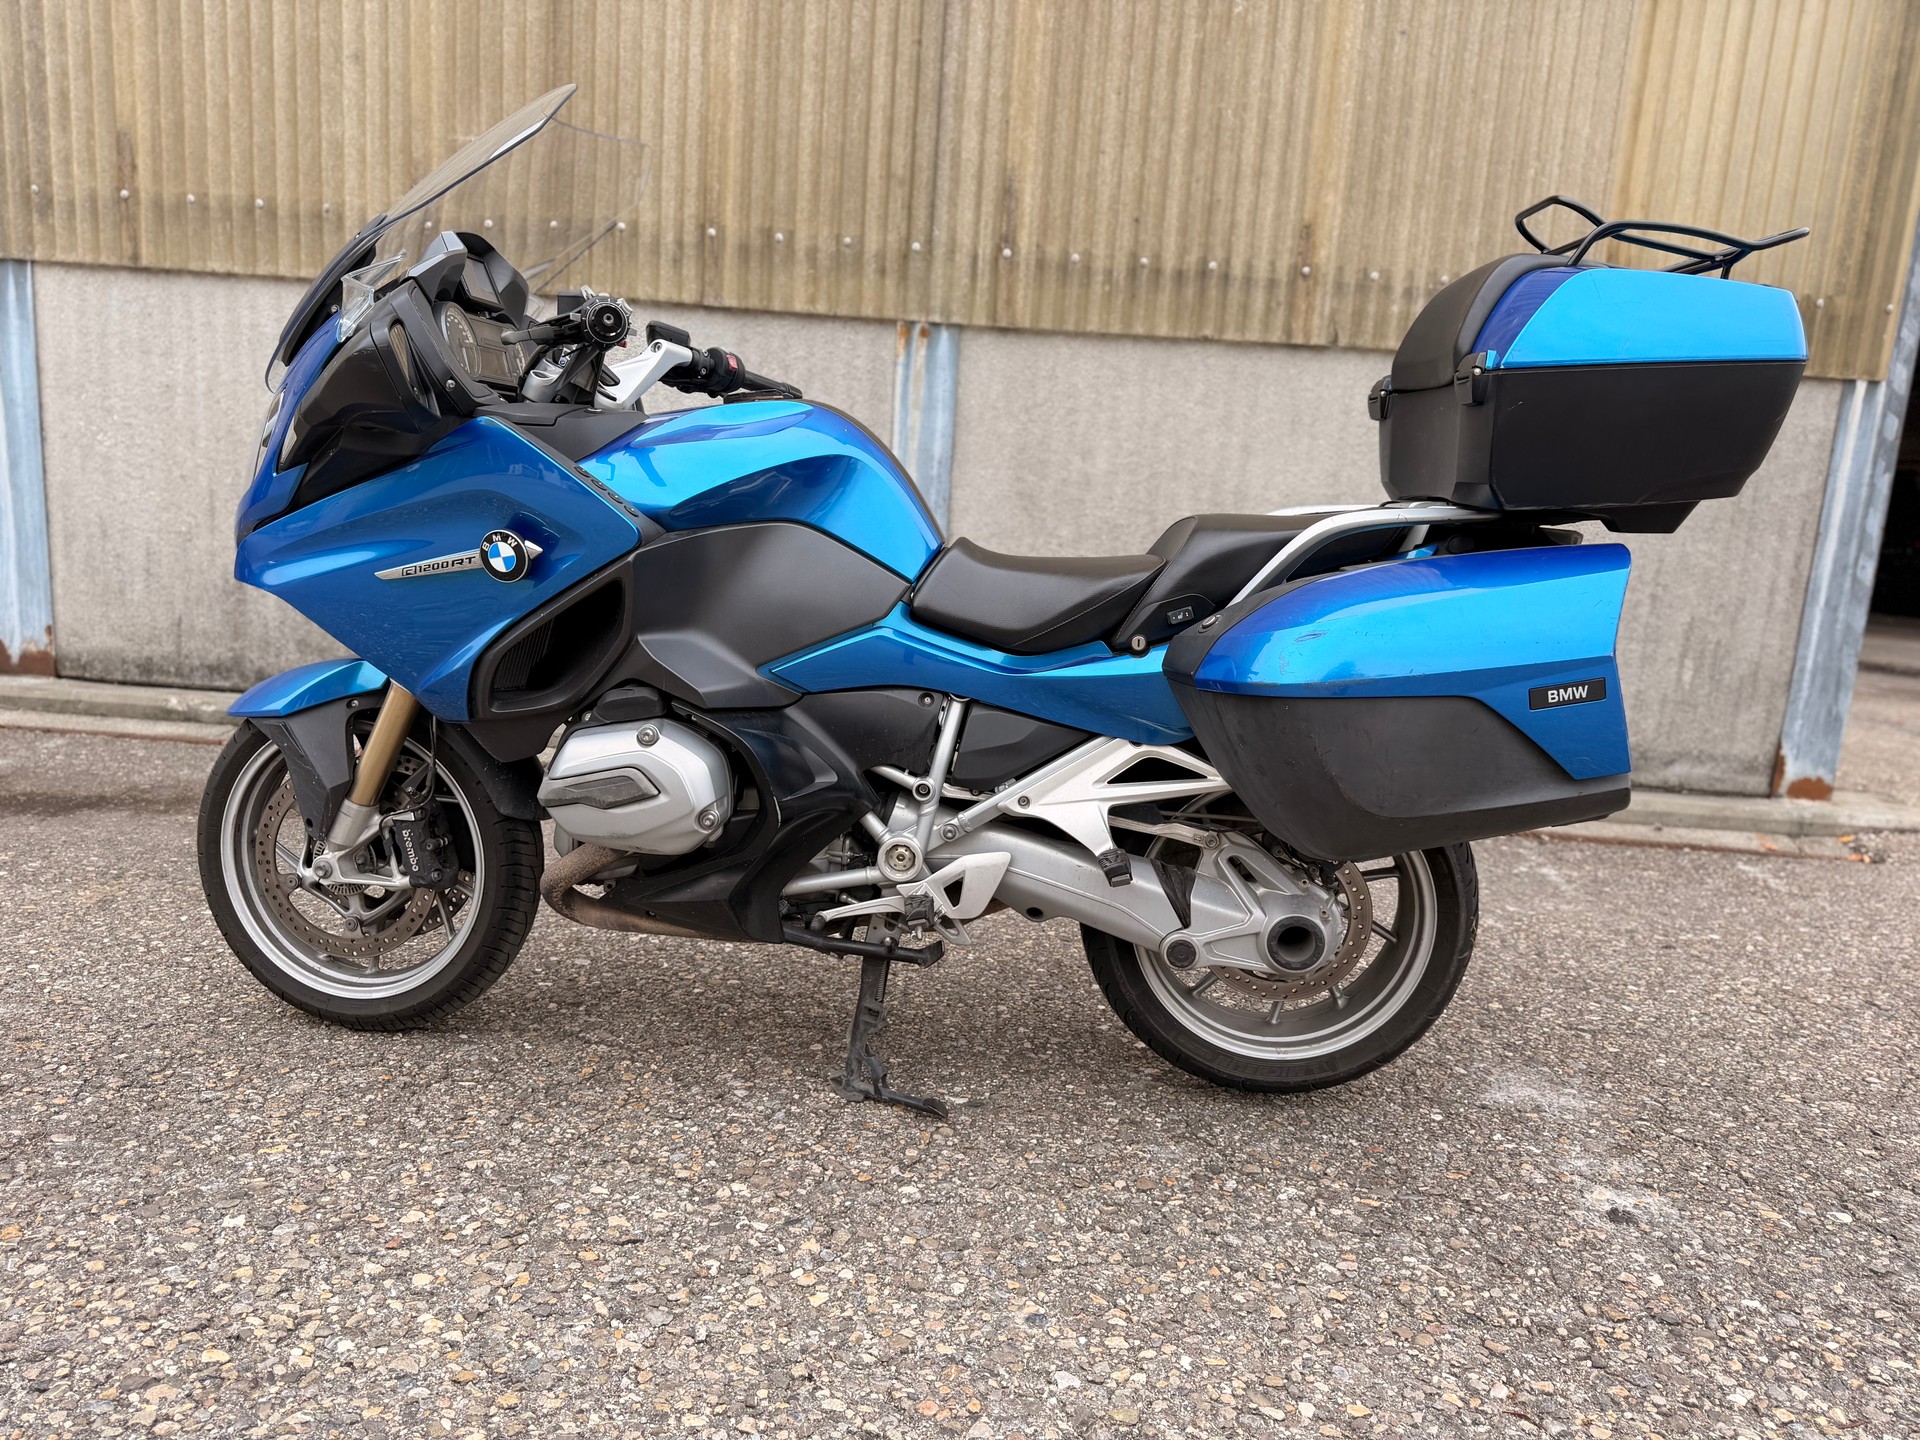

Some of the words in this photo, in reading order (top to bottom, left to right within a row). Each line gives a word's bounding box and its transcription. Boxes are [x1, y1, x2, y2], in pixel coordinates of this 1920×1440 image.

[482, 533, 518, 552] BMW
[1547, 685, 1589, 703] BMW
[402, 829, 419, 872] brembo
